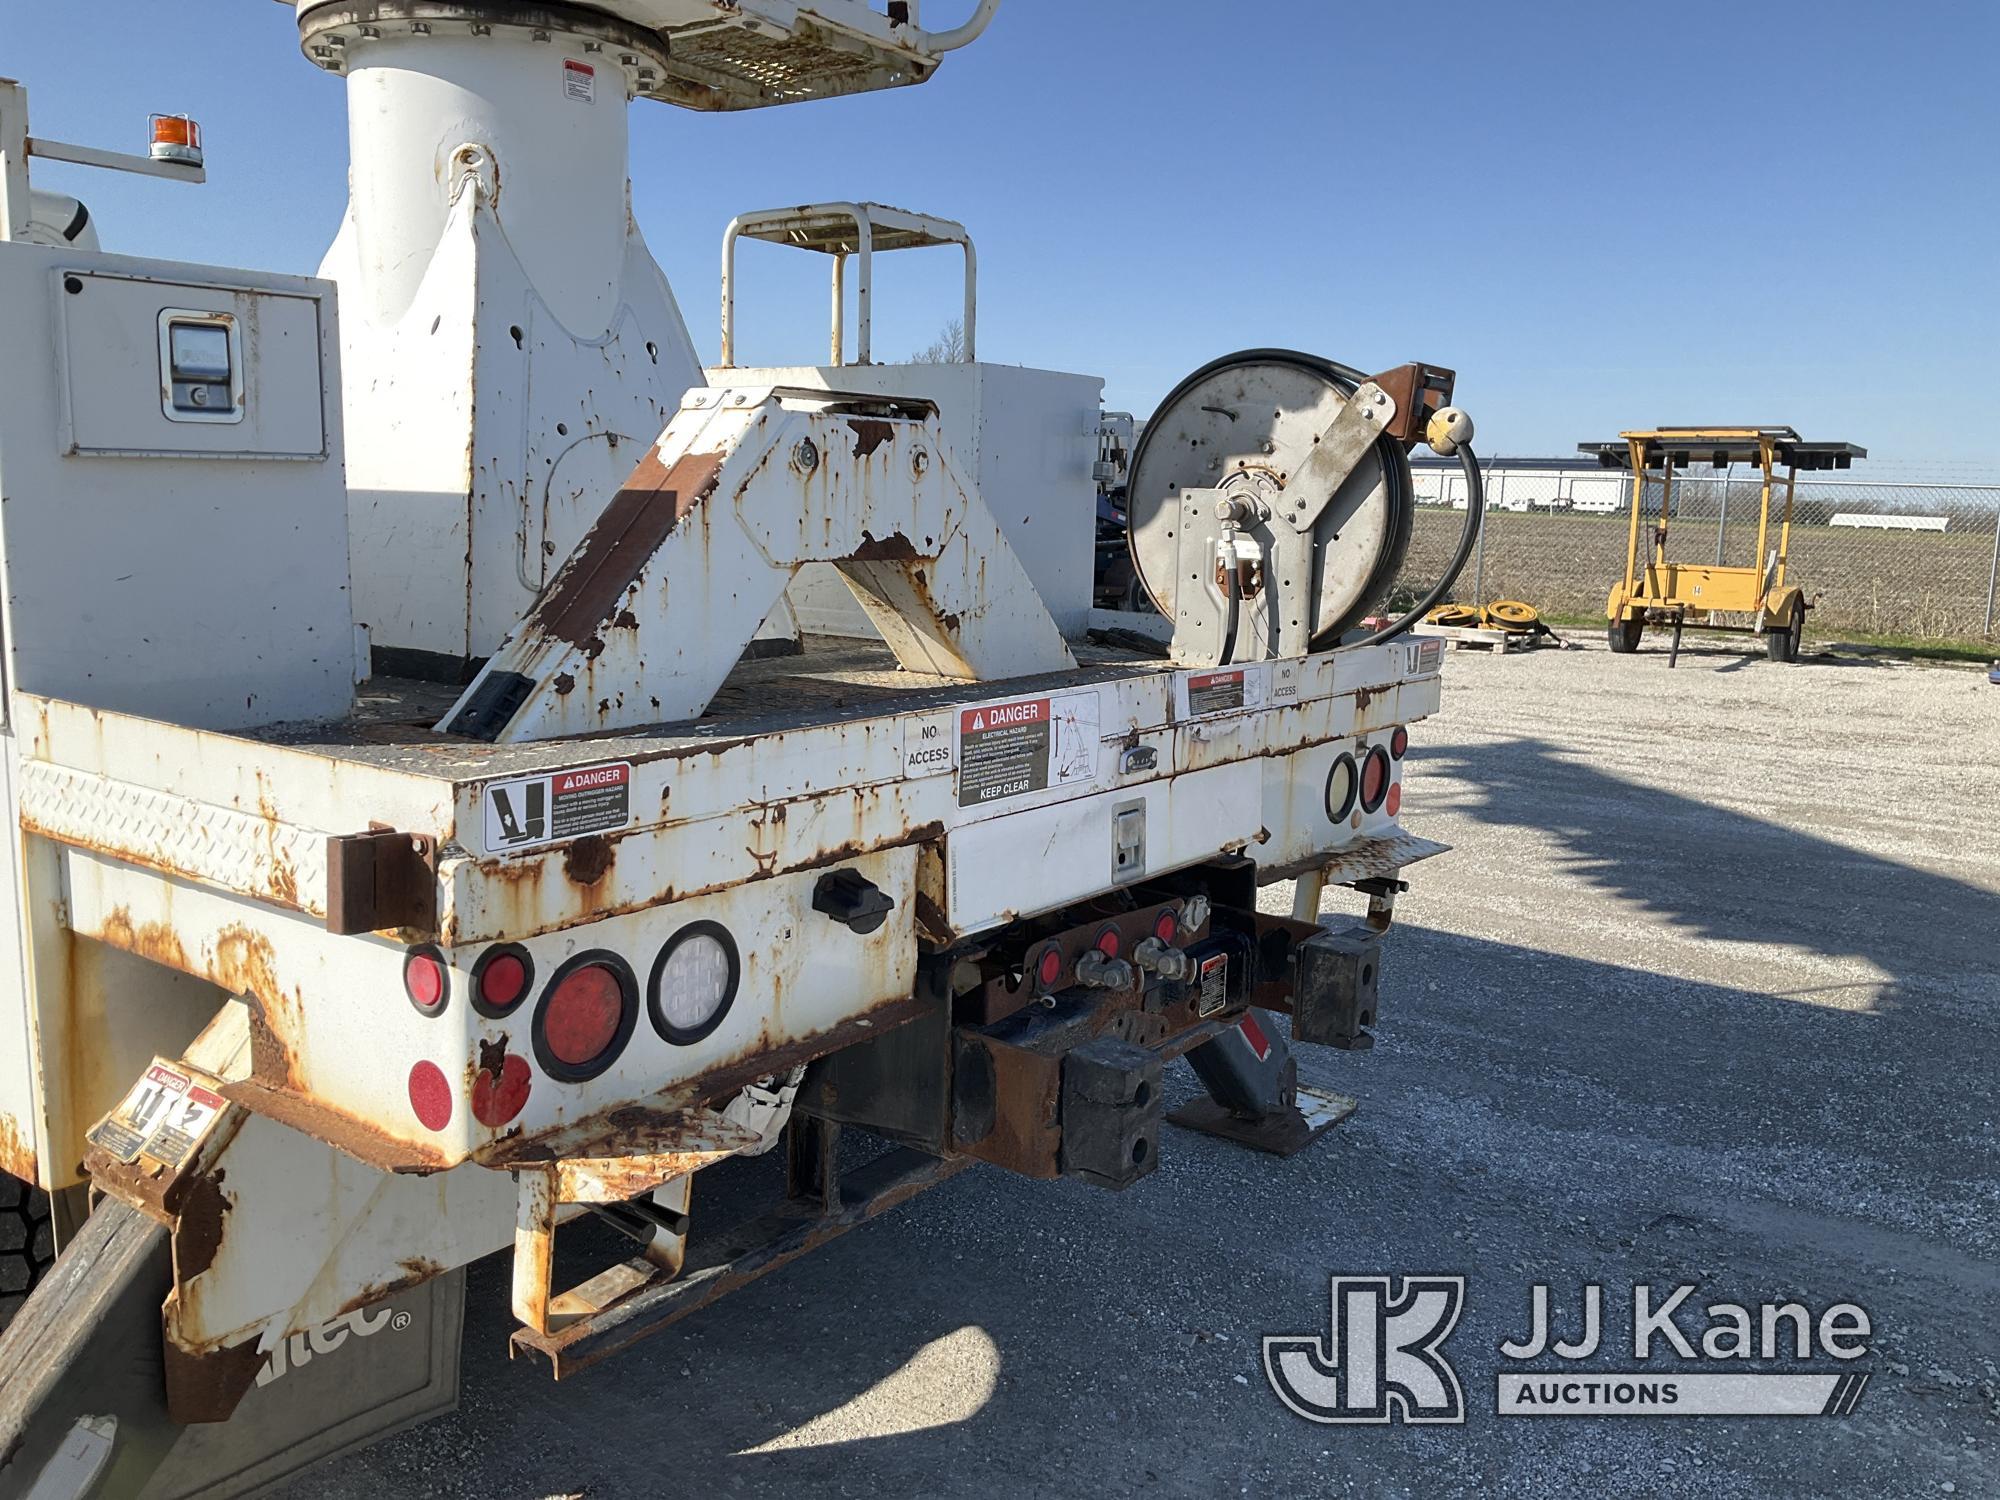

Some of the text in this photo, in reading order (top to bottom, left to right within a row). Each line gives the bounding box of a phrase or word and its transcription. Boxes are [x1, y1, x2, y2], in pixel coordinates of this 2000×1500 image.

[1281, 669, 1290, 679] NO
[1273, 685, 1296, 697] ACCESS
[990, 704, 1038, 725] DANGER
[922, 725, 937, 739] NO
[982, 726, 1028, 740] ELECTRICAL HAZARD
[908, 750, 949, 766] ACCESS
[575, 769, 620, 787] DANGER
[980, 786, 1002, 800] KEEP
[1003, 780, 1029, 795] CLEAR
